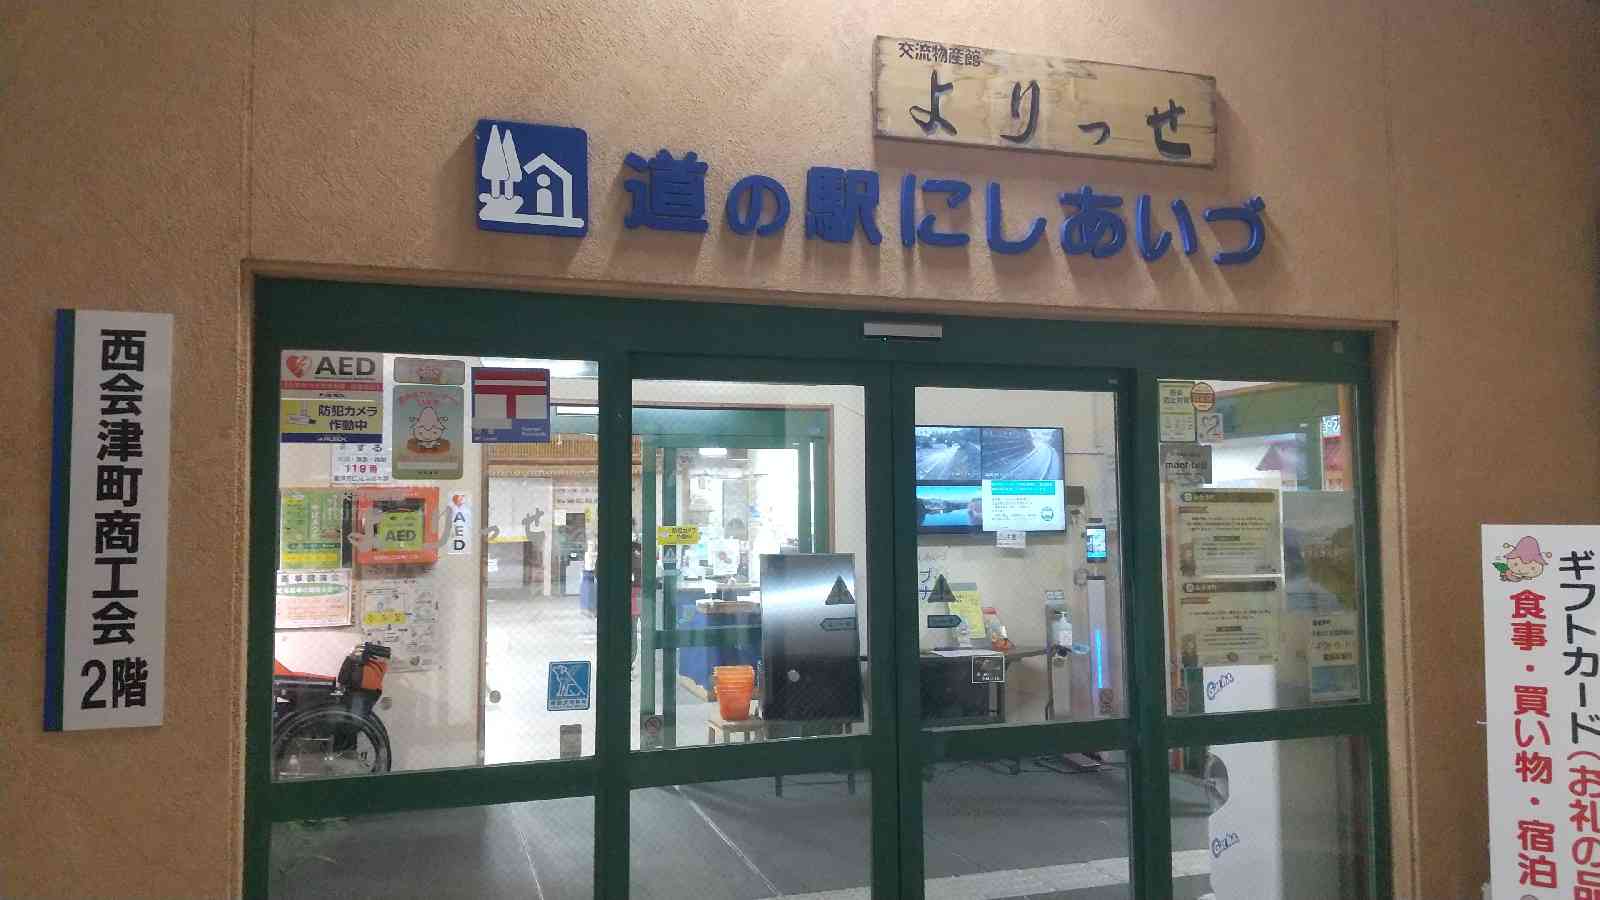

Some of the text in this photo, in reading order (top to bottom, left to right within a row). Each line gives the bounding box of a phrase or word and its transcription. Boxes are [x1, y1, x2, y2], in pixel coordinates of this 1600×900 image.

[898, 41, 984, 67] 交流物産館
[909, 69, 1191, 160] よりっせ
[623, 148, 1266, 265] 道の駅にしあいづ
[315, 356, 376, 376] AED
[319, 404, 378, 417] 防犯カメラ
[329, 419, 368, 431] 作動中
[80, 329, 148, 710] 西会津町商工会 2階
[385, 529, 417, 542] AED
[453, 511, 466, 551] AED
[1509, 589, 1558, 889] 食事・買い物・宿泊
